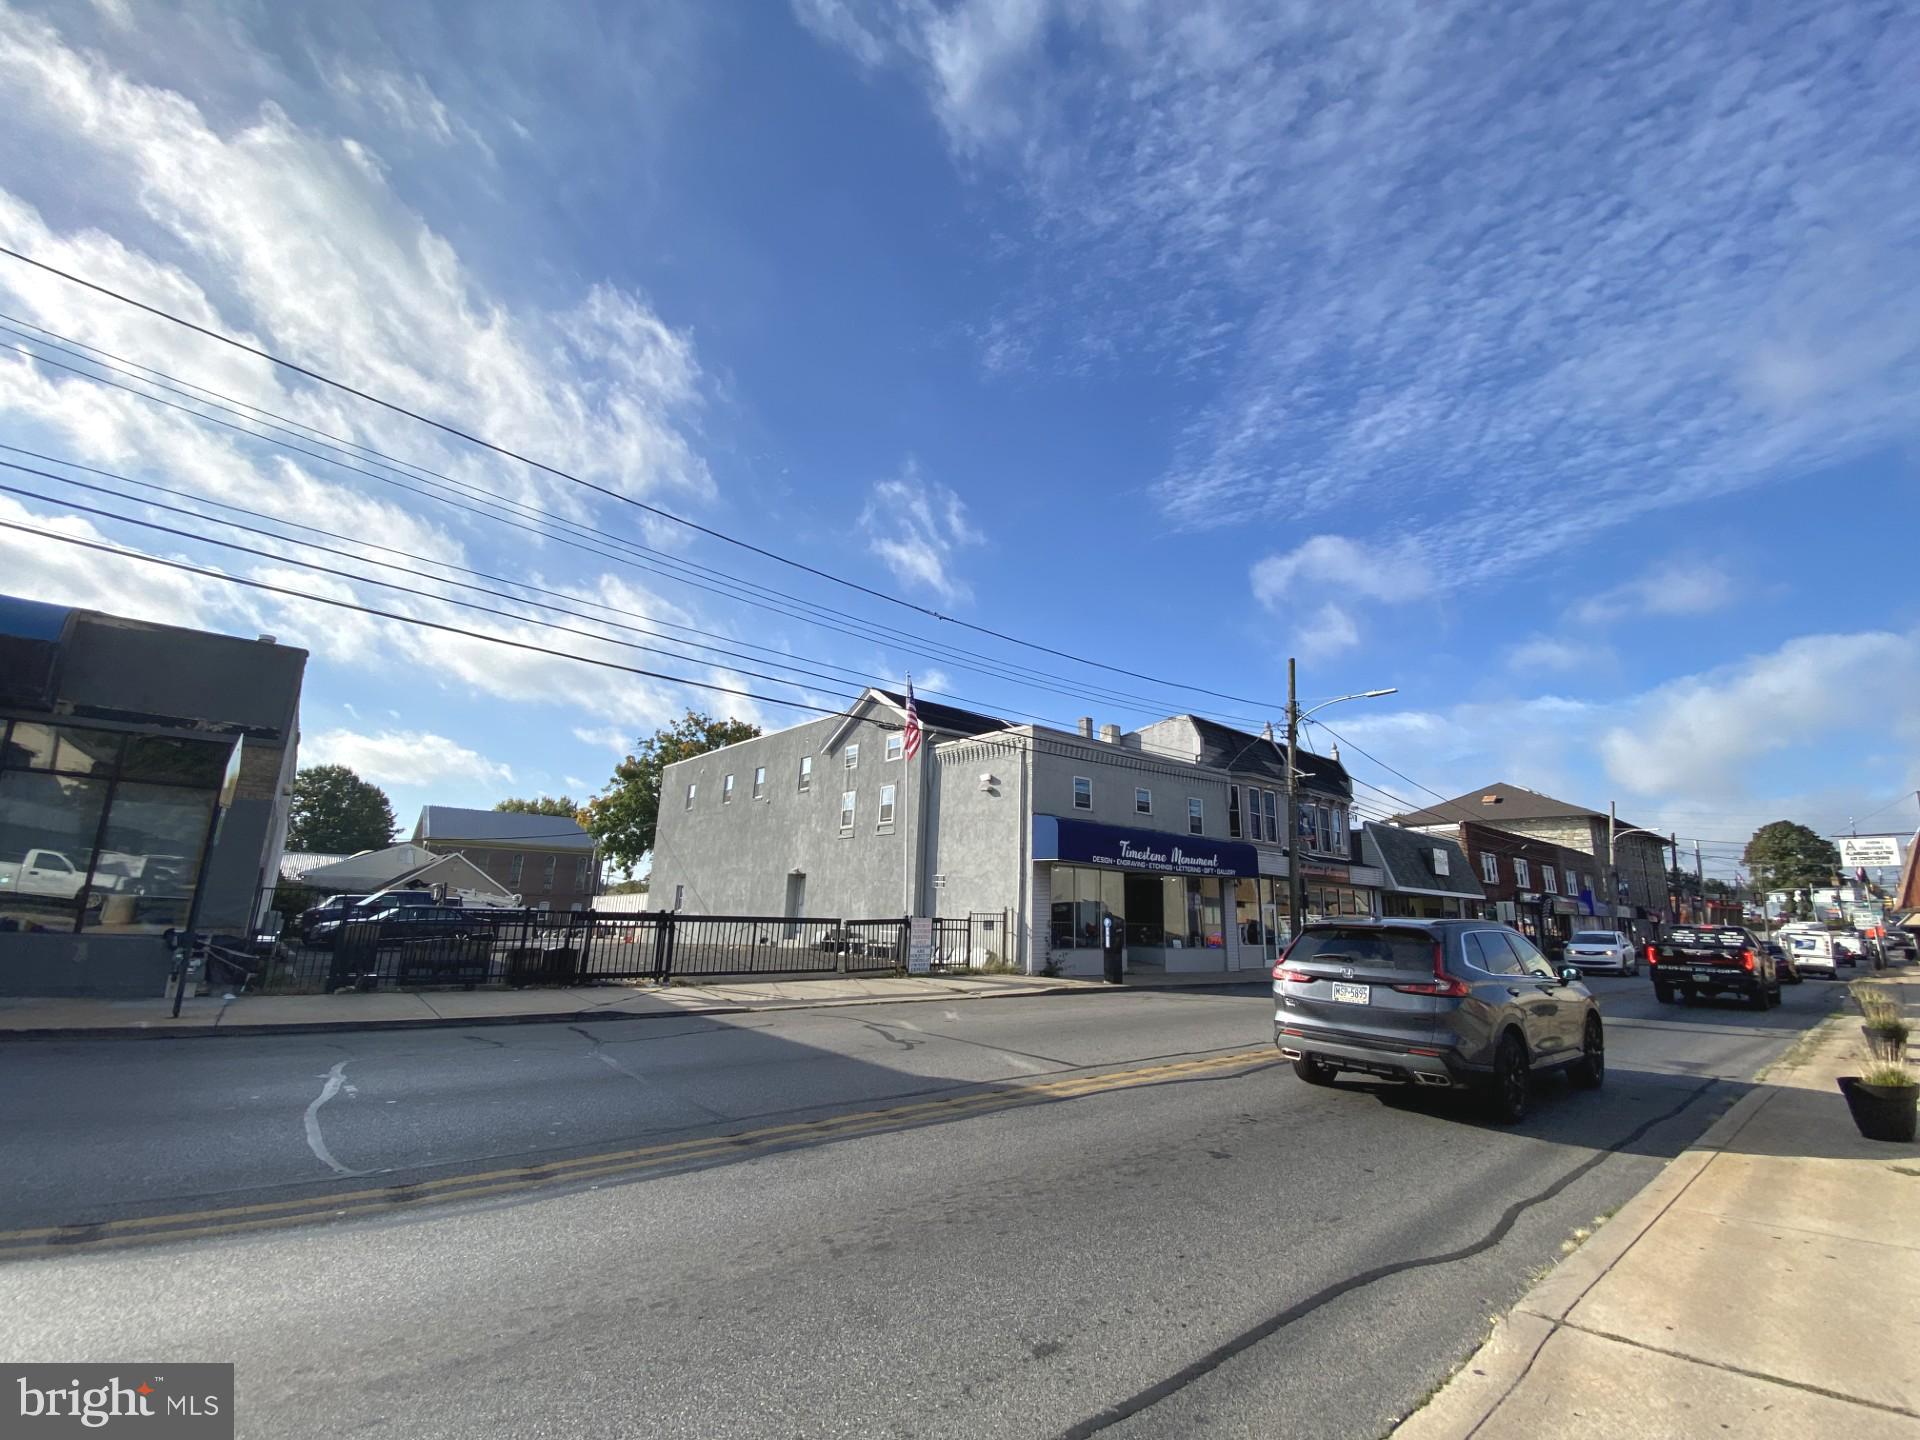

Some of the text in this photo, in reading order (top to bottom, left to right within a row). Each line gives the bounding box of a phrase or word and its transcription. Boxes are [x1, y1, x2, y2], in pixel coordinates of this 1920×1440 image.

[1092, 855, 1113, 864] DESIGN
[1116, 858, 1146, 868] ENGRAVING
[1175, 865, 1201, 873] LETTERING
[1119, 840, 1219, 867] Timestone Monument
